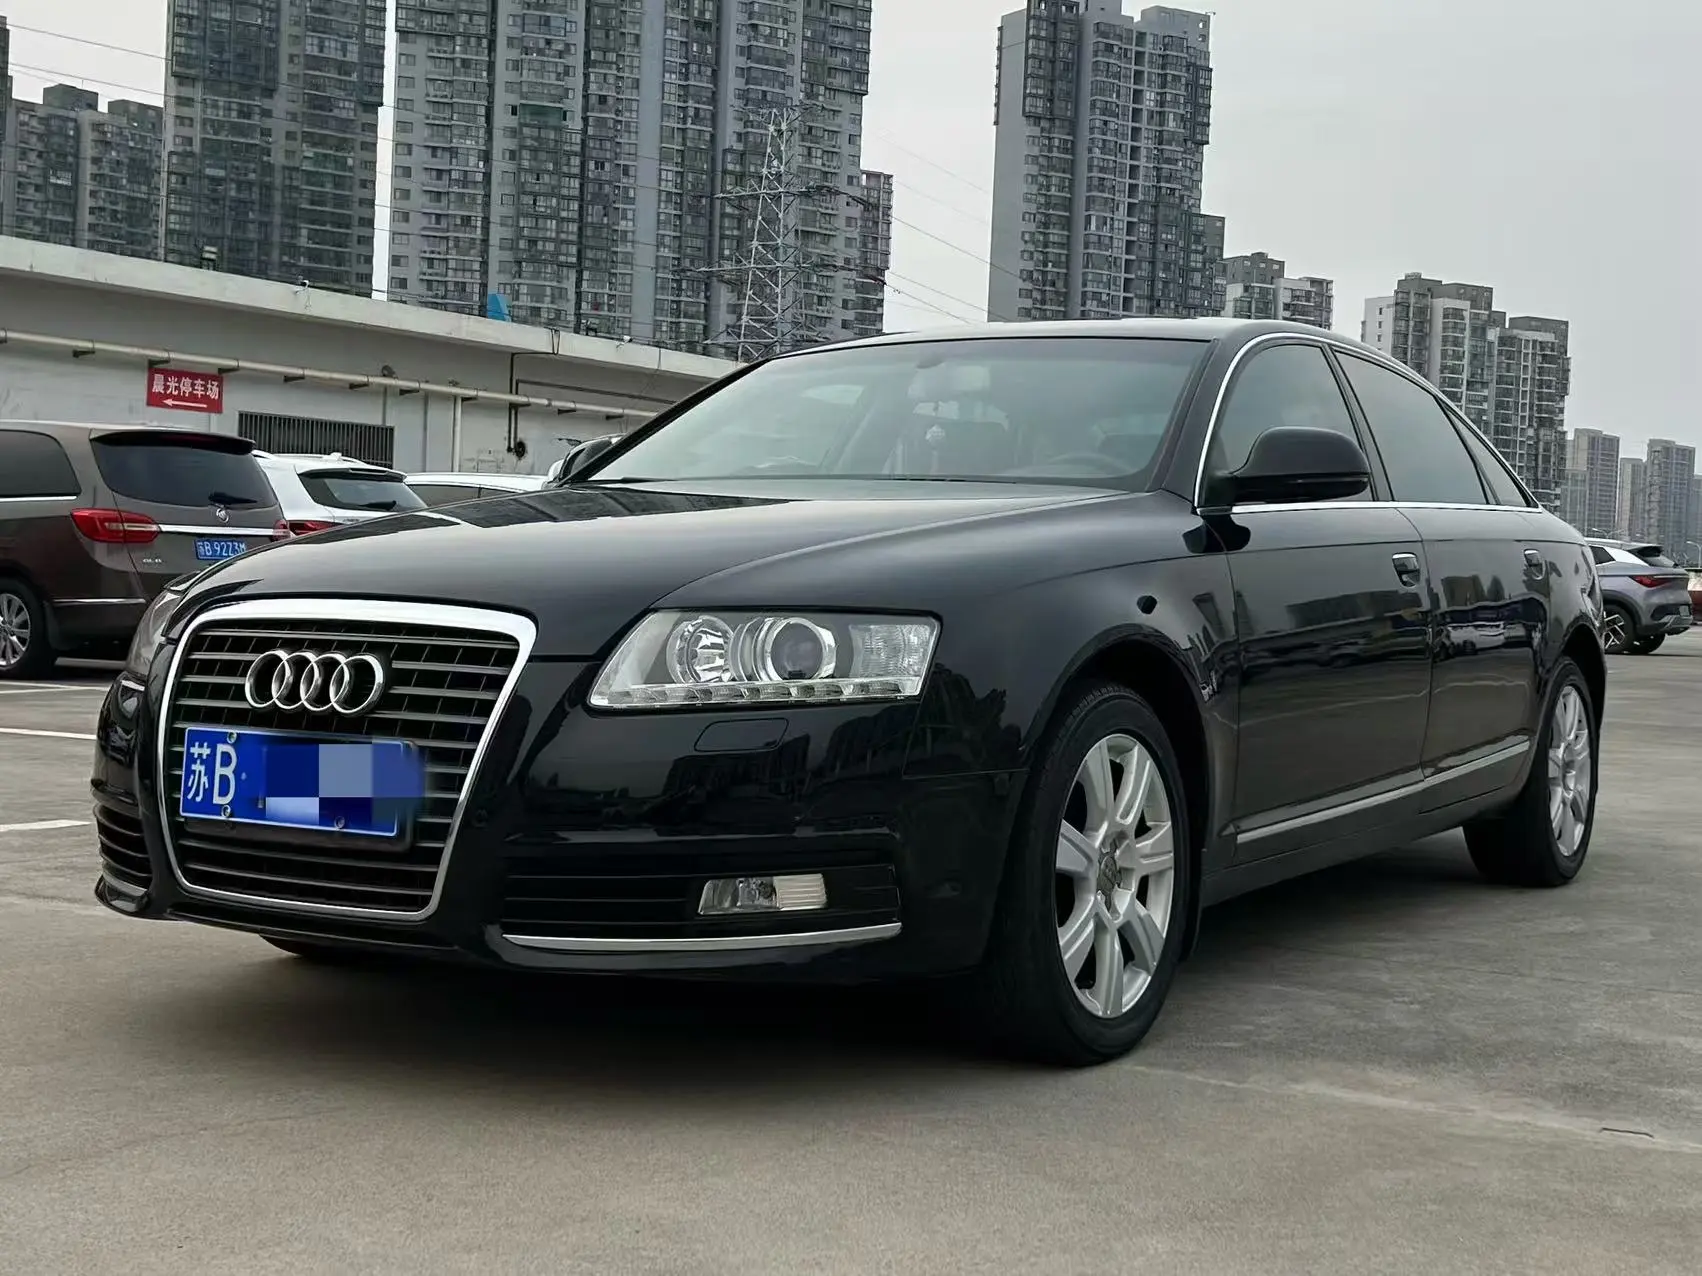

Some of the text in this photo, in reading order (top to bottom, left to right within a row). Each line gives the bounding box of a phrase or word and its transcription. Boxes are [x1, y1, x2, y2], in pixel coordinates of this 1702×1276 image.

[152, 373, 219, 400] 晨光停车场
